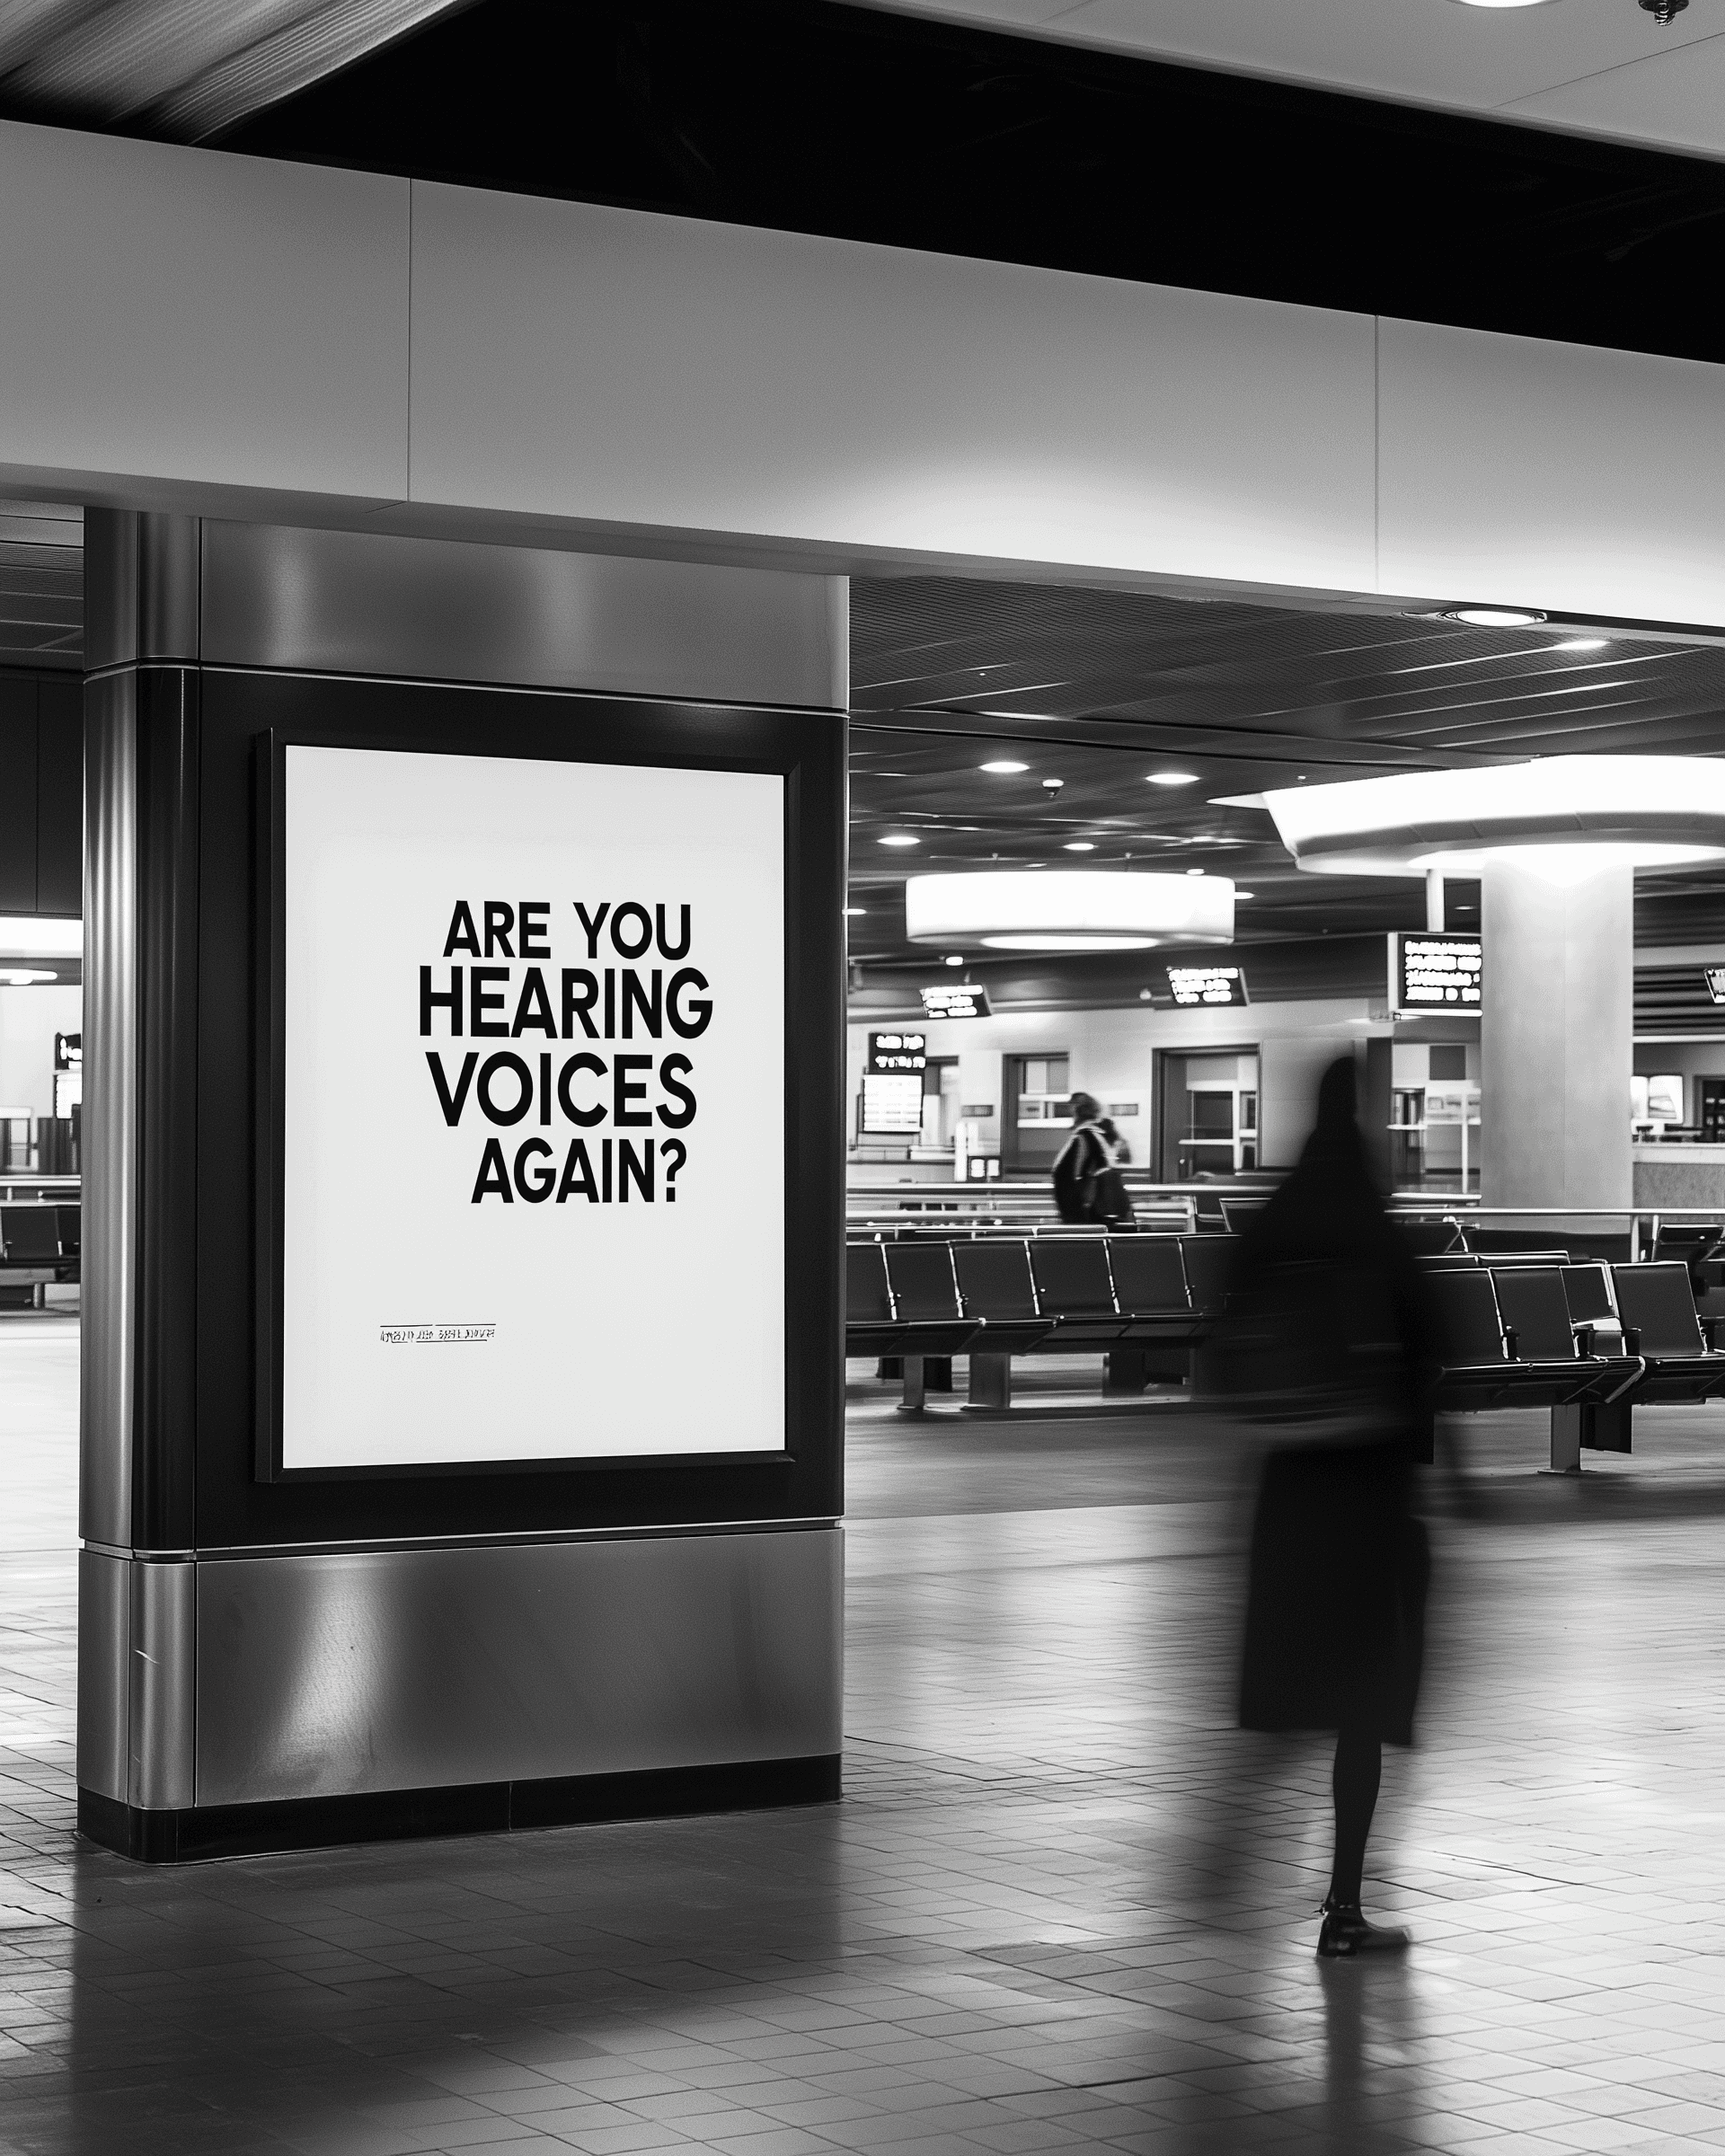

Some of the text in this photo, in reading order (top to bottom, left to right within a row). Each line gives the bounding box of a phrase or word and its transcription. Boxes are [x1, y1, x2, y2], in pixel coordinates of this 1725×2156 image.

[443, 900, 690, 960] ARE YOU
[420, 966, 712, 1038] HEARING
[425, 1051, 696, 1128] VOICES
[471, 1137, 686, 1203] AGAIN?
